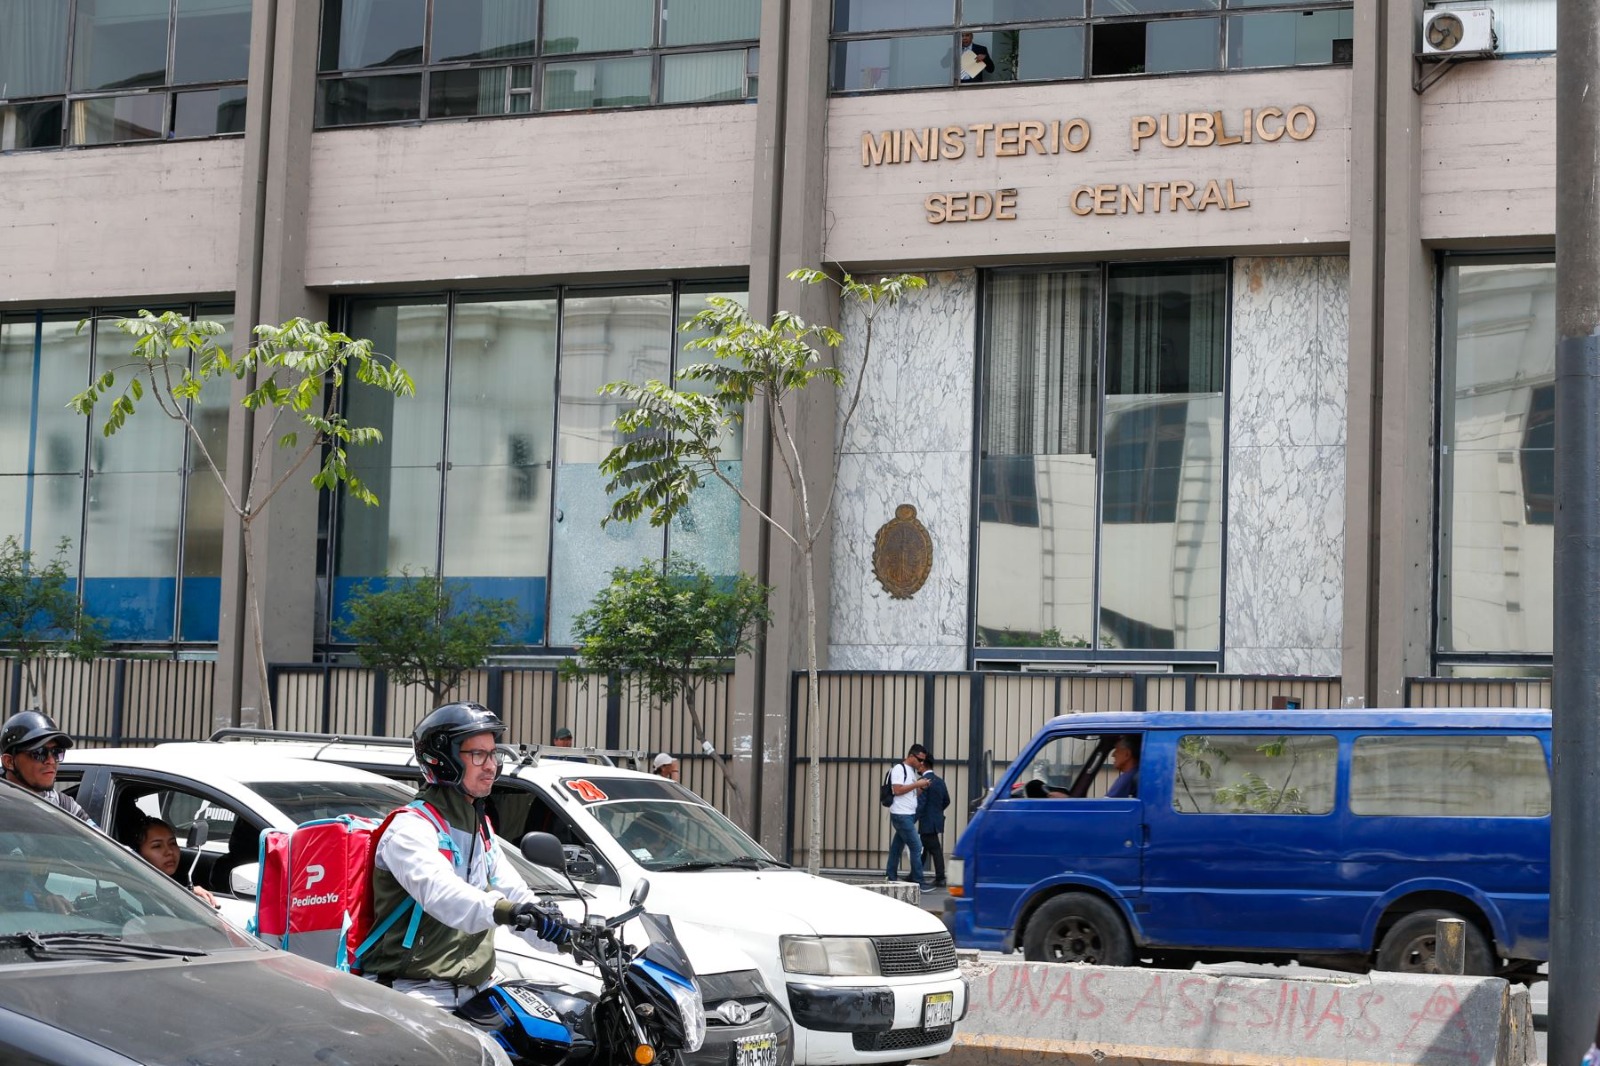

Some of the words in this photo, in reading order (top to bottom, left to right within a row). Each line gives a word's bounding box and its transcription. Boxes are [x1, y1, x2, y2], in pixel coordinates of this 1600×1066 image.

[861, 118, 1091, 167] MINISTERIO
[1131, 104, 1318, 152] PUBLICO
[924, 188, 1019, 224] SEDE
[1069, 178, 1251, 216] CENTRAL
[204, 807, 236, 822] PUMA
[291, 893, 339, 908] PedidosYa
[968, 963, 1105, 1019] UNAS
[1123, 975, 1385, 1044] ASESINAS
